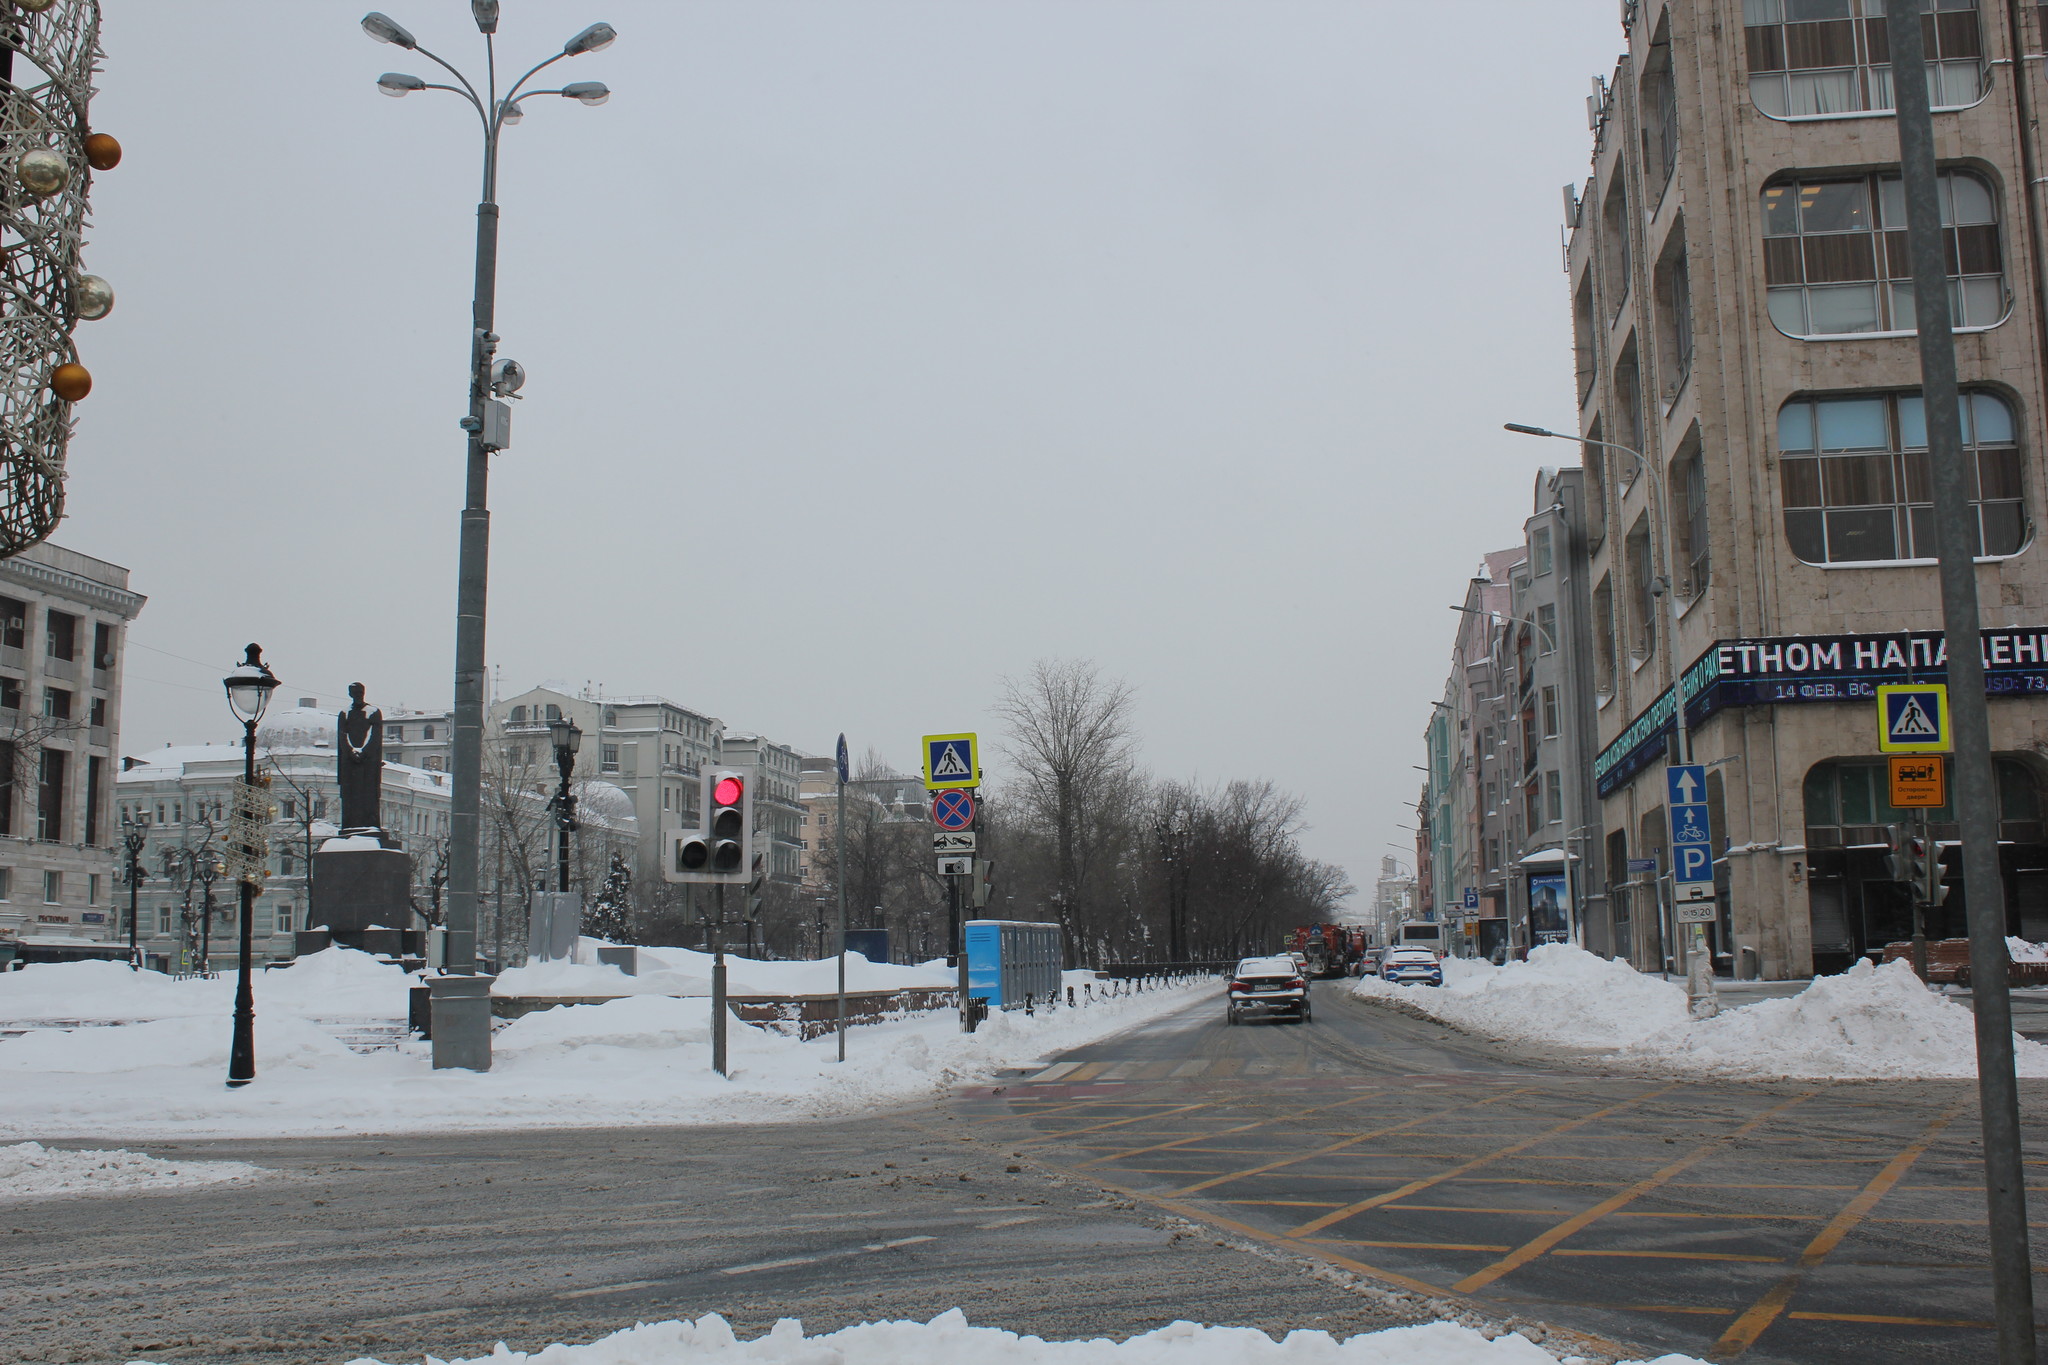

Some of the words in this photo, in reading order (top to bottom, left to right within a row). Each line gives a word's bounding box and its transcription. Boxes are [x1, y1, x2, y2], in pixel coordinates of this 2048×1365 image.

[1776, 685, 1796, 698] 14
[1684, 848, 1706, 879] P
[1467, 895, 1476, 907] P
[1700, 907, 1711, 917] 20
[38, 914, 69, 924] РЕСТОРАН
